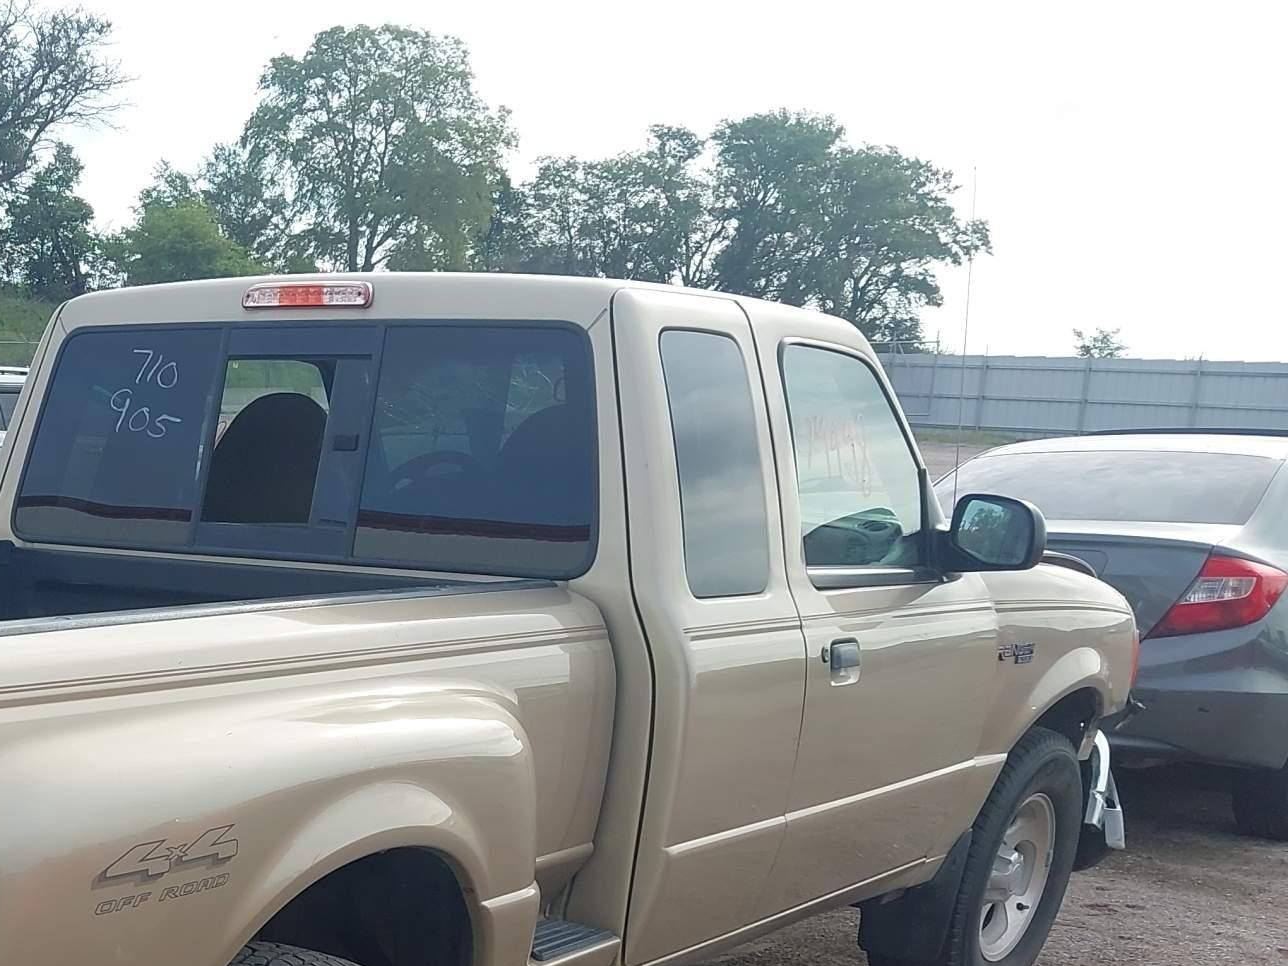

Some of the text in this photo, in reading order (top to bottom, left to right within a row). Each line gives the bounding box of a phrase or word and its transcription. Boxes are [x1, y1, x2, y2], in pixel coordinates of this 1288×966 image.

[133, 349, 178, 389] 710
[110, 388, 182, 438] 905
[97, 823, 239, 884] 4x4
[94, 872, 230, 916] OFF ROAD
